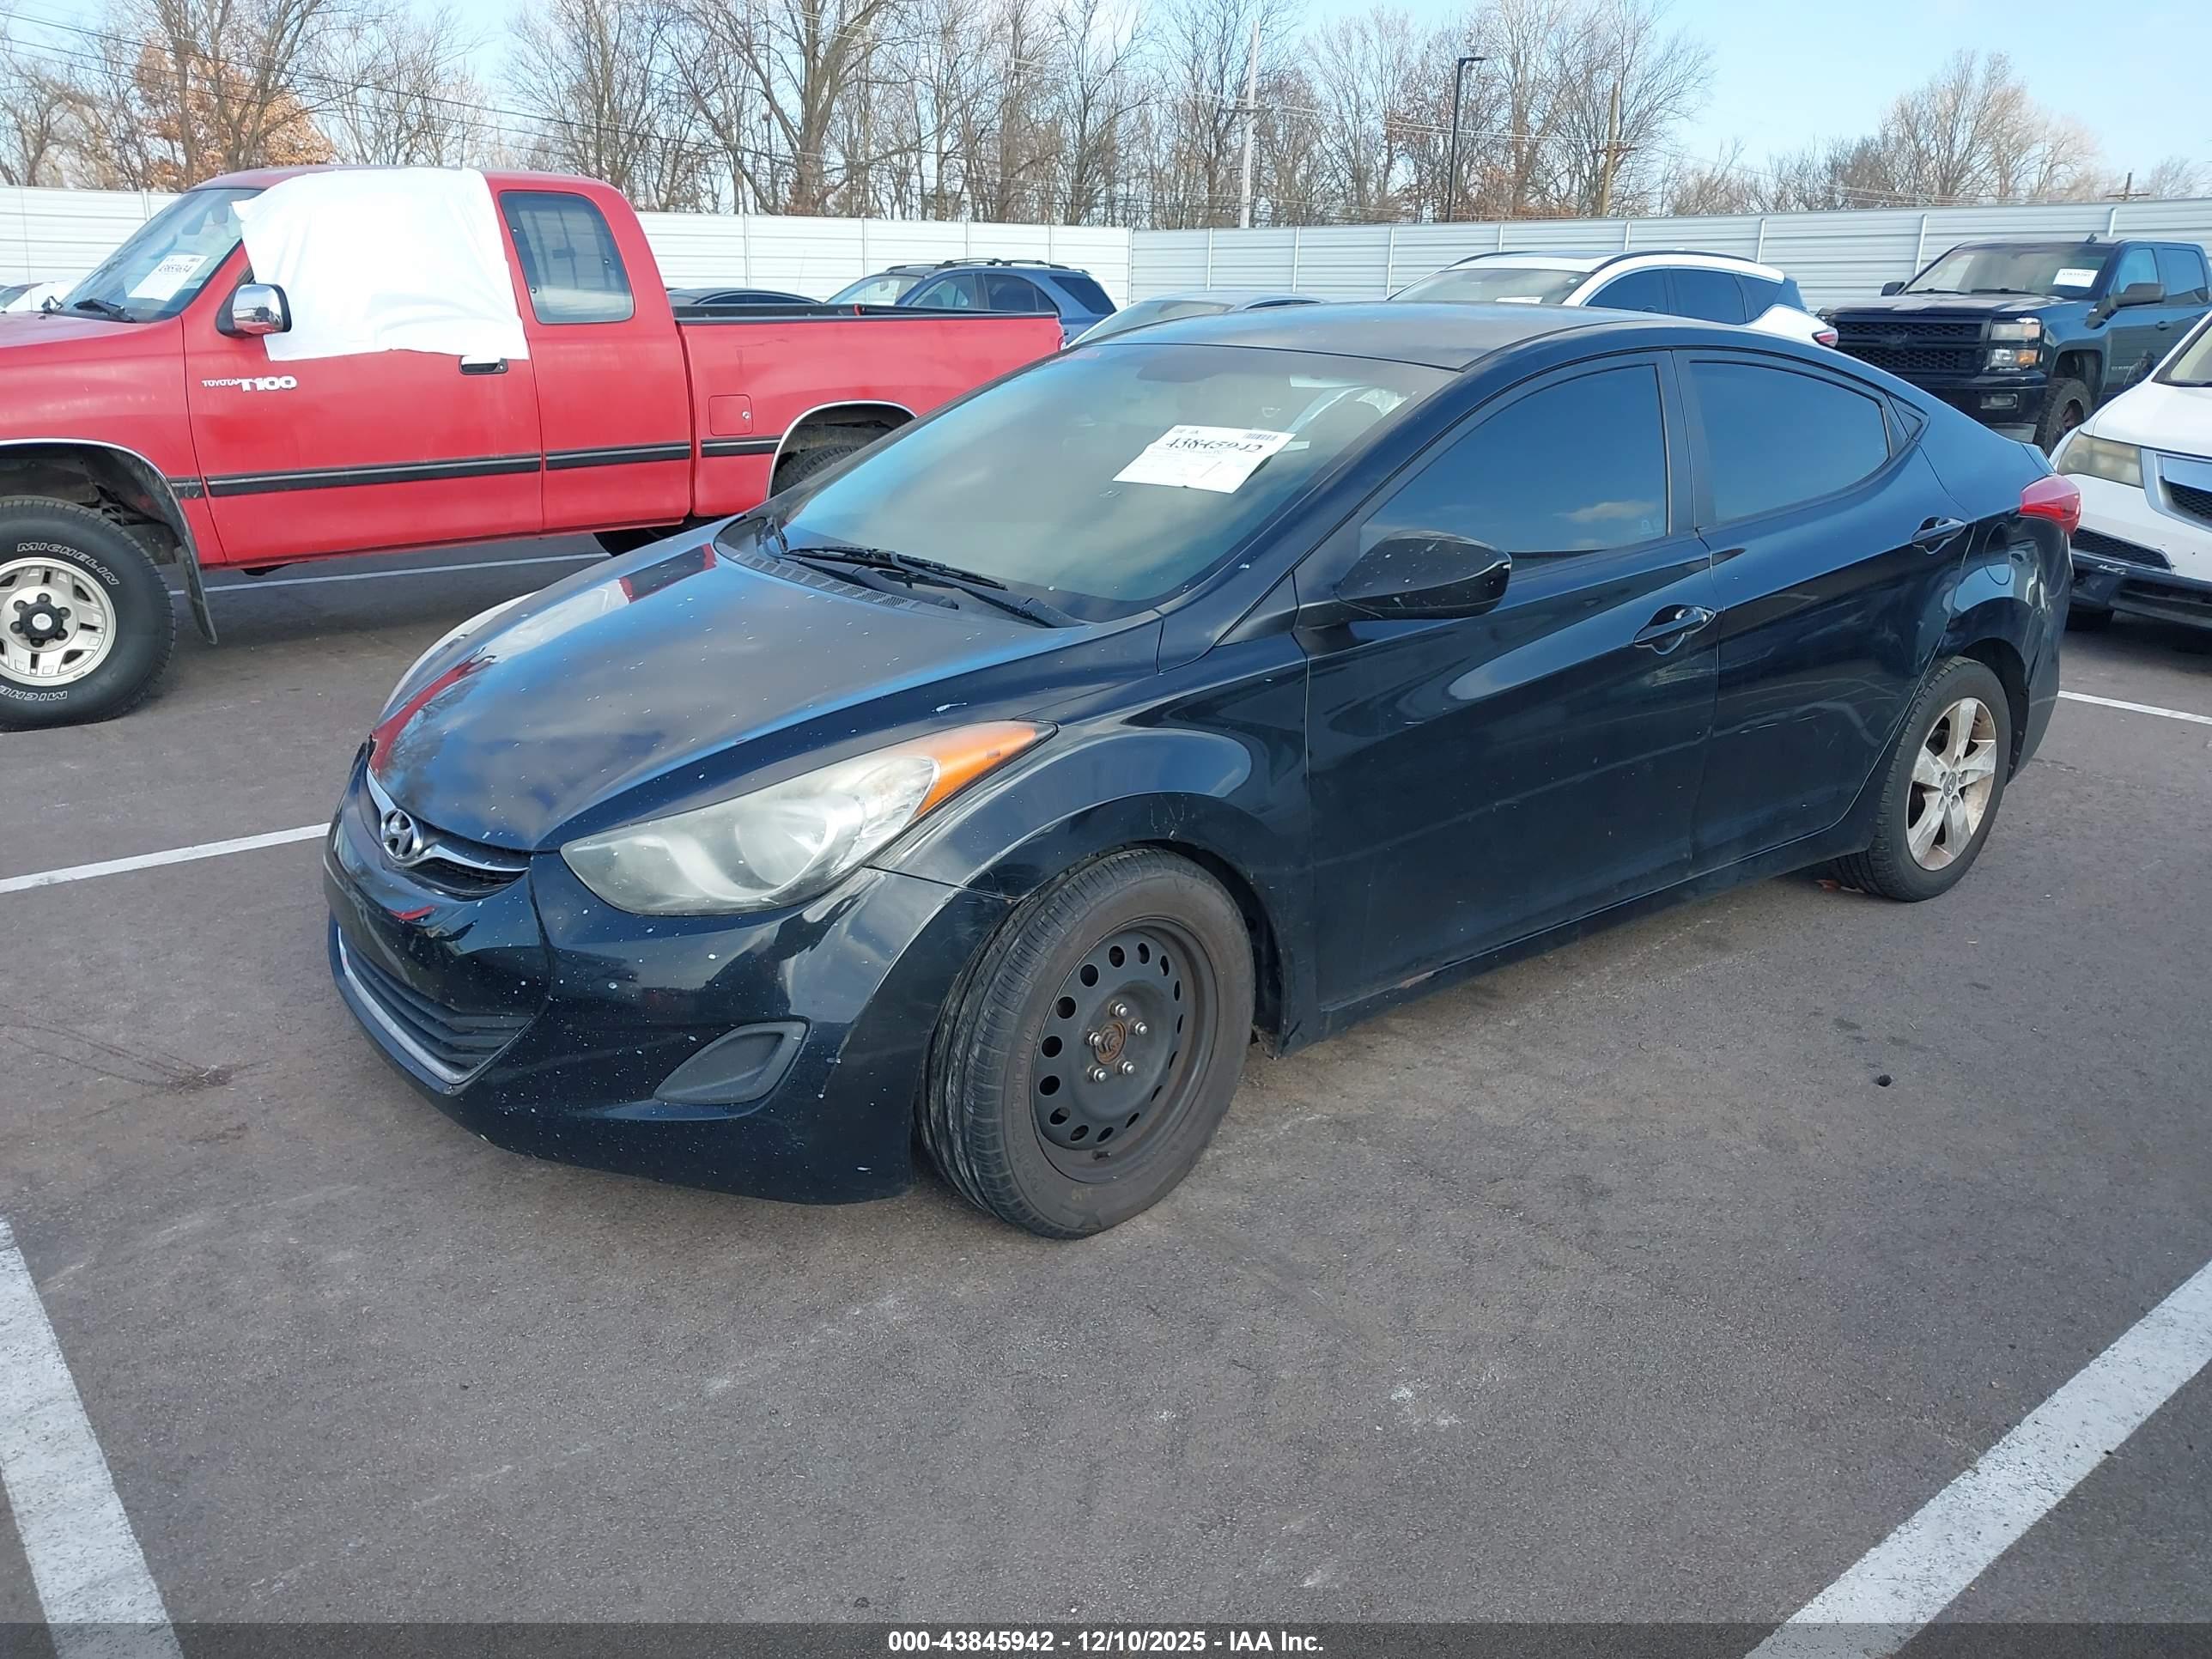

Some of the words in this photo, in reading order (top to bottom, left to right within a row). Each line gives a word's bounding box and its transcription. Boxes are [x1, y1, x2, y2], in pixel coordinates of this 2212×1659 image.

[201, 378, 240, 387] TOYOTA
[238, 375, 298, 392] T100
[16, 542, 120, 586] MICHELIN
